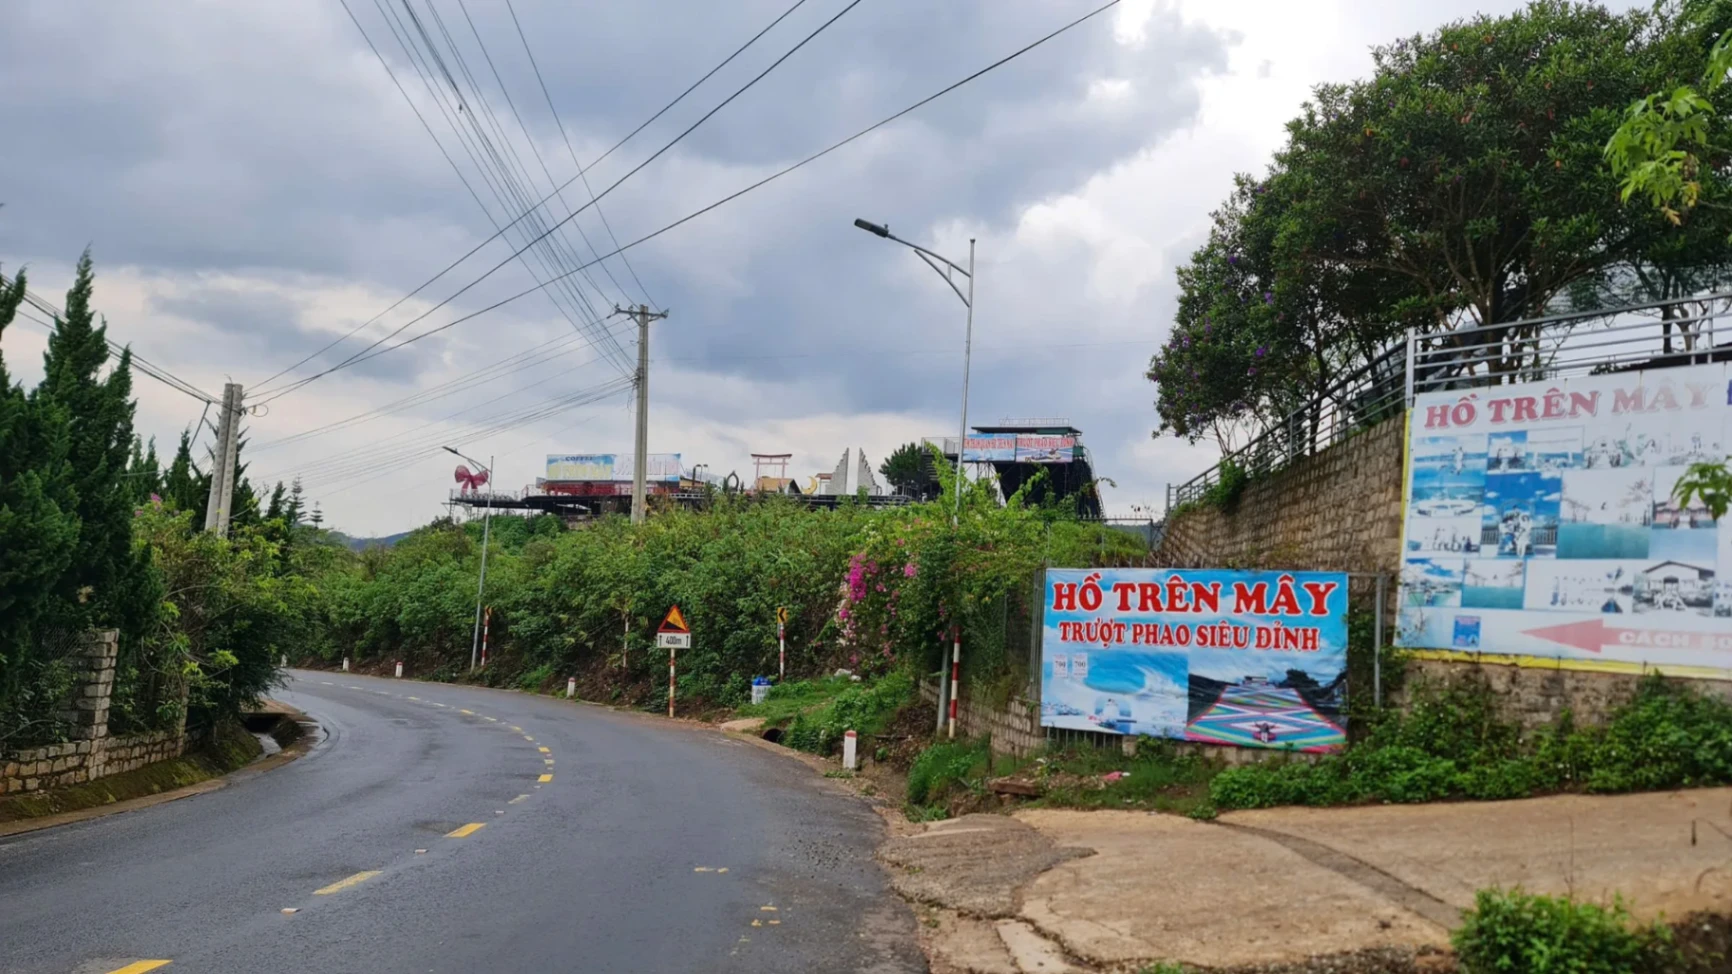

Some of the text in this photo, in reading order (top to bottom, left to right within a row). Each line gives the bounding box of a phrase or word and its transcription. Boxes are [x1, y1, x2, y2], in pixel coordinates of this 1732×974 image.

[1424, 394, 1479, 429] HỒ
[1487, 388, 1603, 423] TRÊN
[1052, 573, 1338, 616] HỒ TRÊN MÂY
[665, 635, 682, 645] 400m
[1058, 618, 1320, 651] TRƯỢT PHAO SIÊU ĐỈNH
